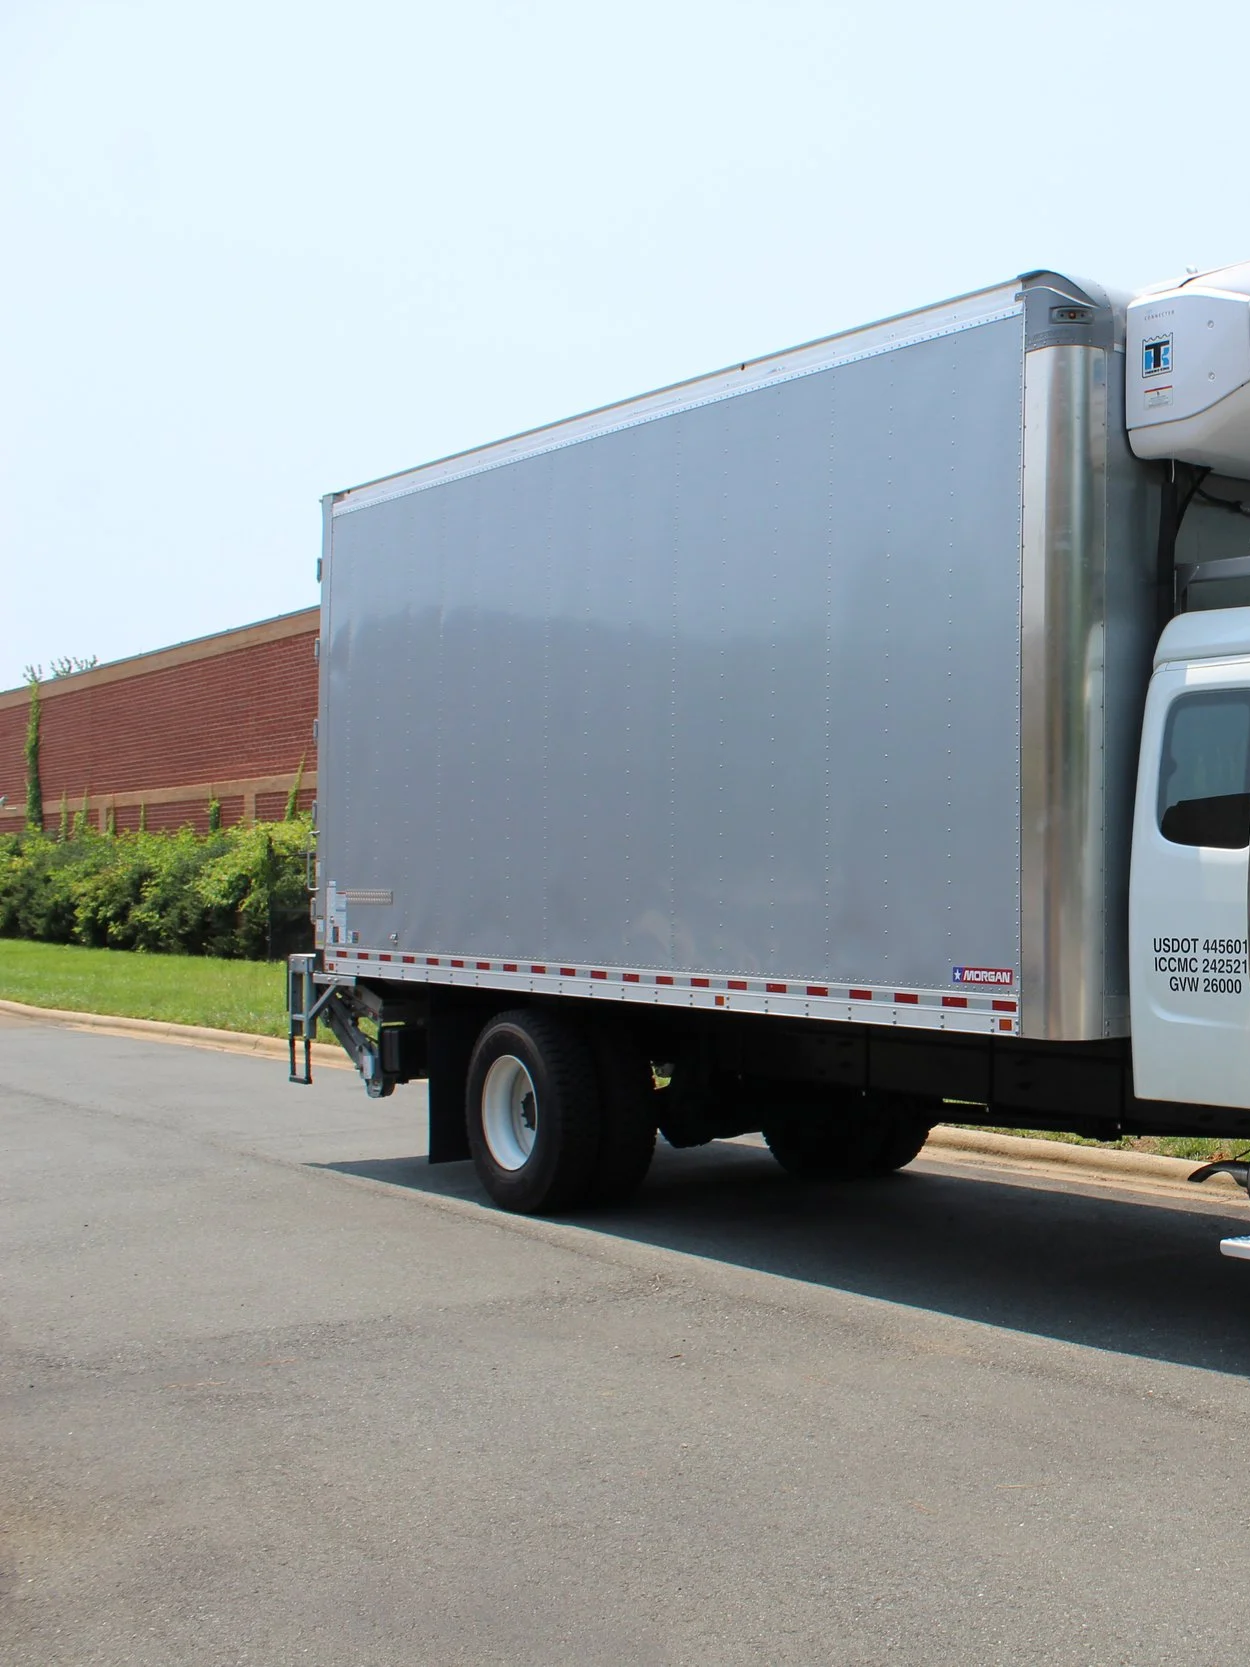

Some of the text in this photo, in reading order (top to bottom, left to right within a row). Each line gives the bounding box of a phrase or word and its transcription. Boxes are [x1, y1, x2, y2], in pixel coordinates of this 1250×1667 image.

[1153, 938, 1247, 954] USDOT 445601
[1154, 957, 1247, 974] ICCMC 242521
[963, 970, 1012, 983] MORGAN
[1169, 976, 1242, 994] GVW 26000
